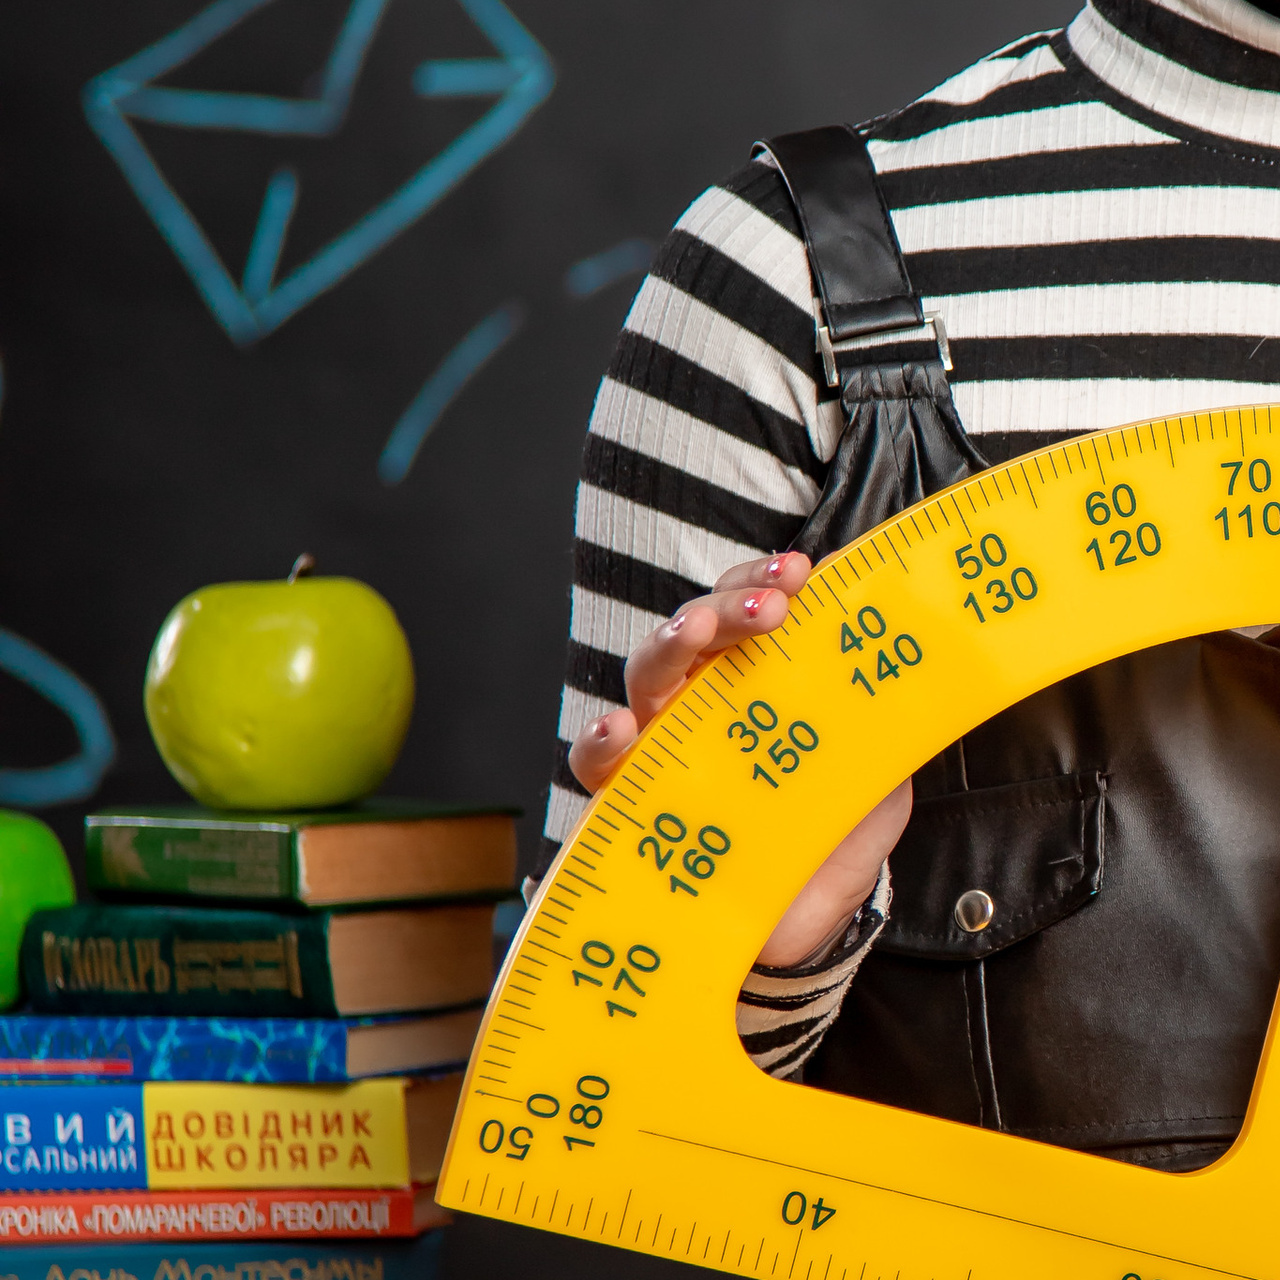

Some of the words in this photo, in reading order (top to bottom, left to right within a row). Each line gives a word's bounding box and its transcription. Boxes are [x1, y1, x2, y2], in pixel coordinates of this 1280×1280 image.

[1221, 458, 1272, 496] 70
[1086, 484, 1137, 526] 60
[956, 533, 1007, 580] 50
[1087, 522, 1162, 571] 120
[964, 567, 1038, 623] 130
[841, 606, 887, 653] 40
[850, 632, 923, 696] 140
[728, 700, 779, 752] 30
[753, 720, 820, 788] 150
[639, 813, 688, 870] 20
[668, 824, 731, 897] 160
[573, 940, 616, 986] 10
[607, 944, 661, 1017] 170
[153, 1110, 373, 1143] ДОВІДНИК
[528, 1093, 560, 1118] 0
[564, 1075, 610, 1147] 180
[0, 1144, 138, 1175] САЛЬНИЙ
[154, 1142, 372, 1172] ШКОЛЯРА
[480, 1119, 533, 1160] 50
[270, 1195, 391, 1234] РЕВОЛЮЦІЇ
[782, 1191, 837, 1230] 40
